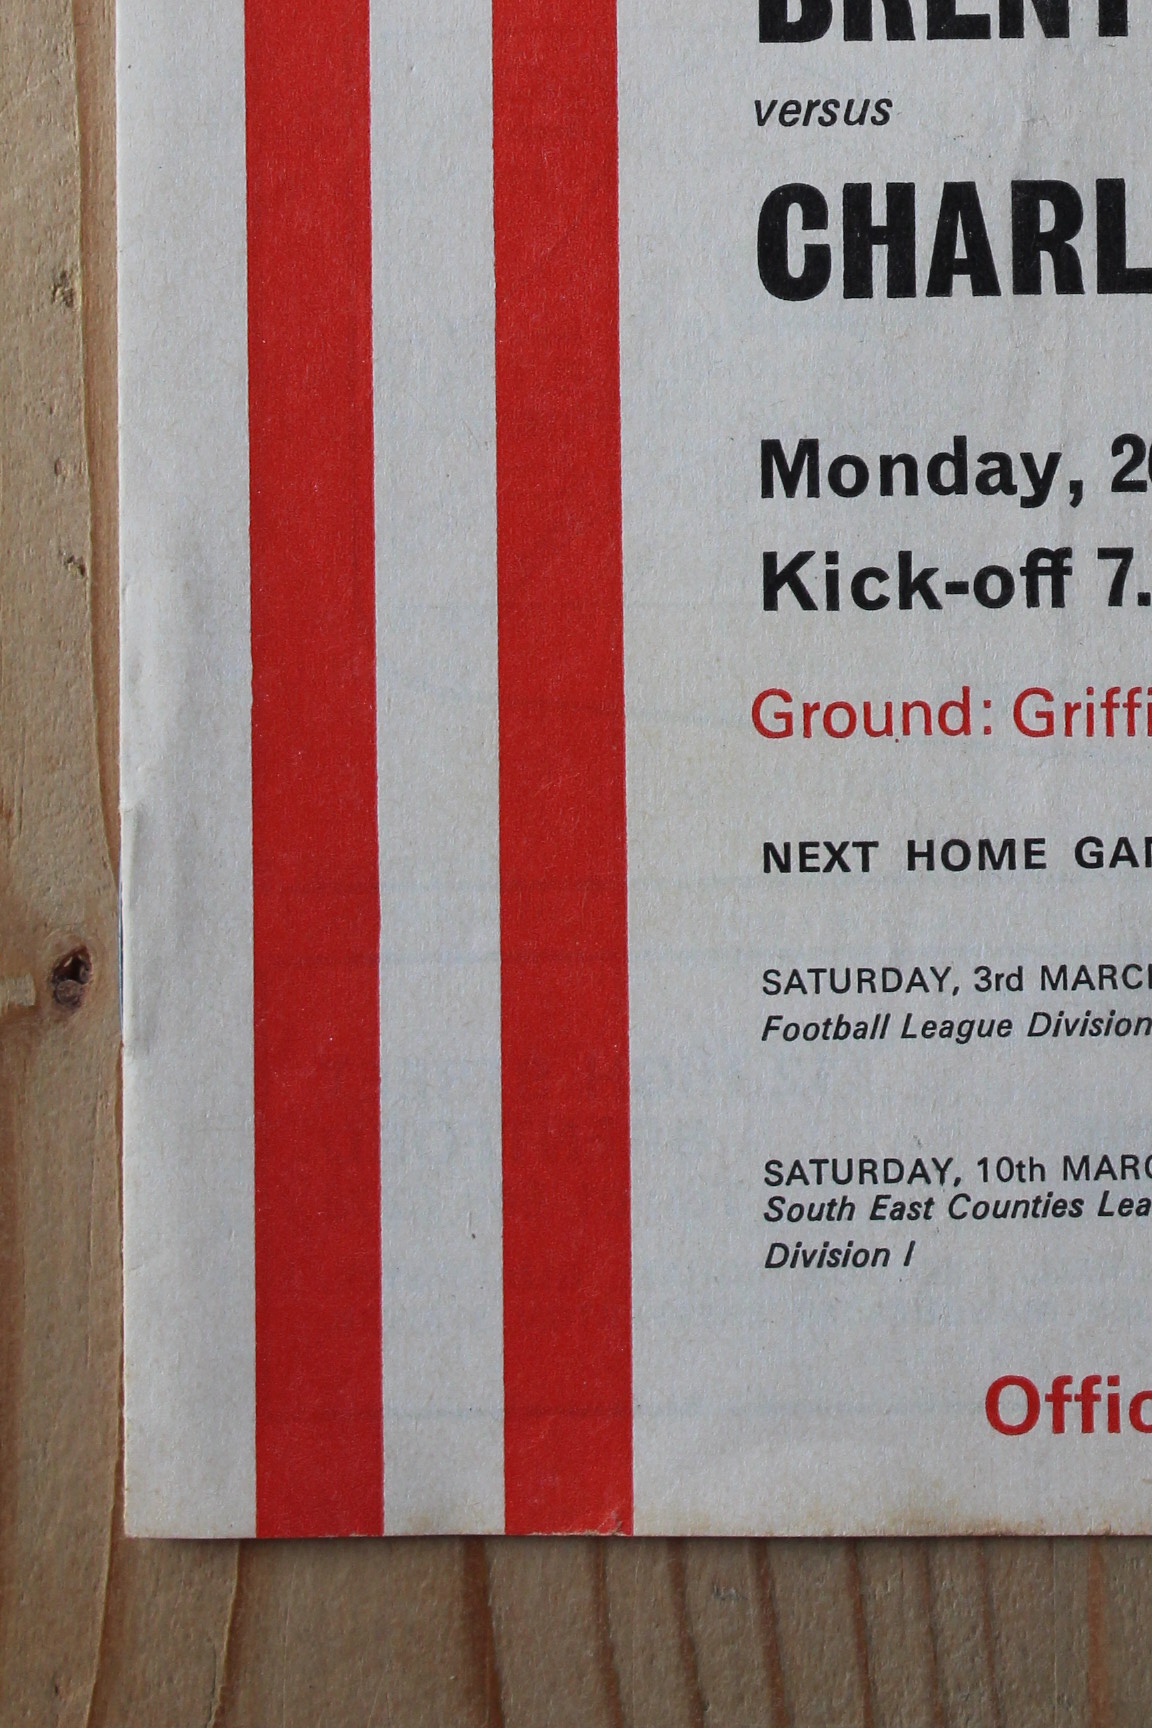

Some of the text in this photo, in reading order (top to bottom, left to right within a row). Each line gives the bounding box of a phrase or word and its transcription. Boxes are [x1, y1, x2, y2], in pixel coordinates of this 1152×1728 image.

[753, 96, 894, 129] versus
[759, 433, 1085, 510] Monday,
[761, 545, 1074, 613] Kick-off
[750, 684, 993, 740] Ground:
[762, 839, 881, 875] NEXT
[906, 836, 1048, 873] HOME
[761, 965, 961, 998] SATURDAY,
[972, 964, 1025, 994] 3rd
[760, 1011, 892, 1043] Football
[899, 1011, 1014, 1046] League
[762, 1156, 963, 1189] SATURDAY,
[976, 1155, 1047, 1185] 10th
[762, 1194, 857, 1224] South
[868, 1193, 937, 1222] East
[946, 1190, 1086, 1222] Counties
[763, 1239, 917, 1270] Division I
